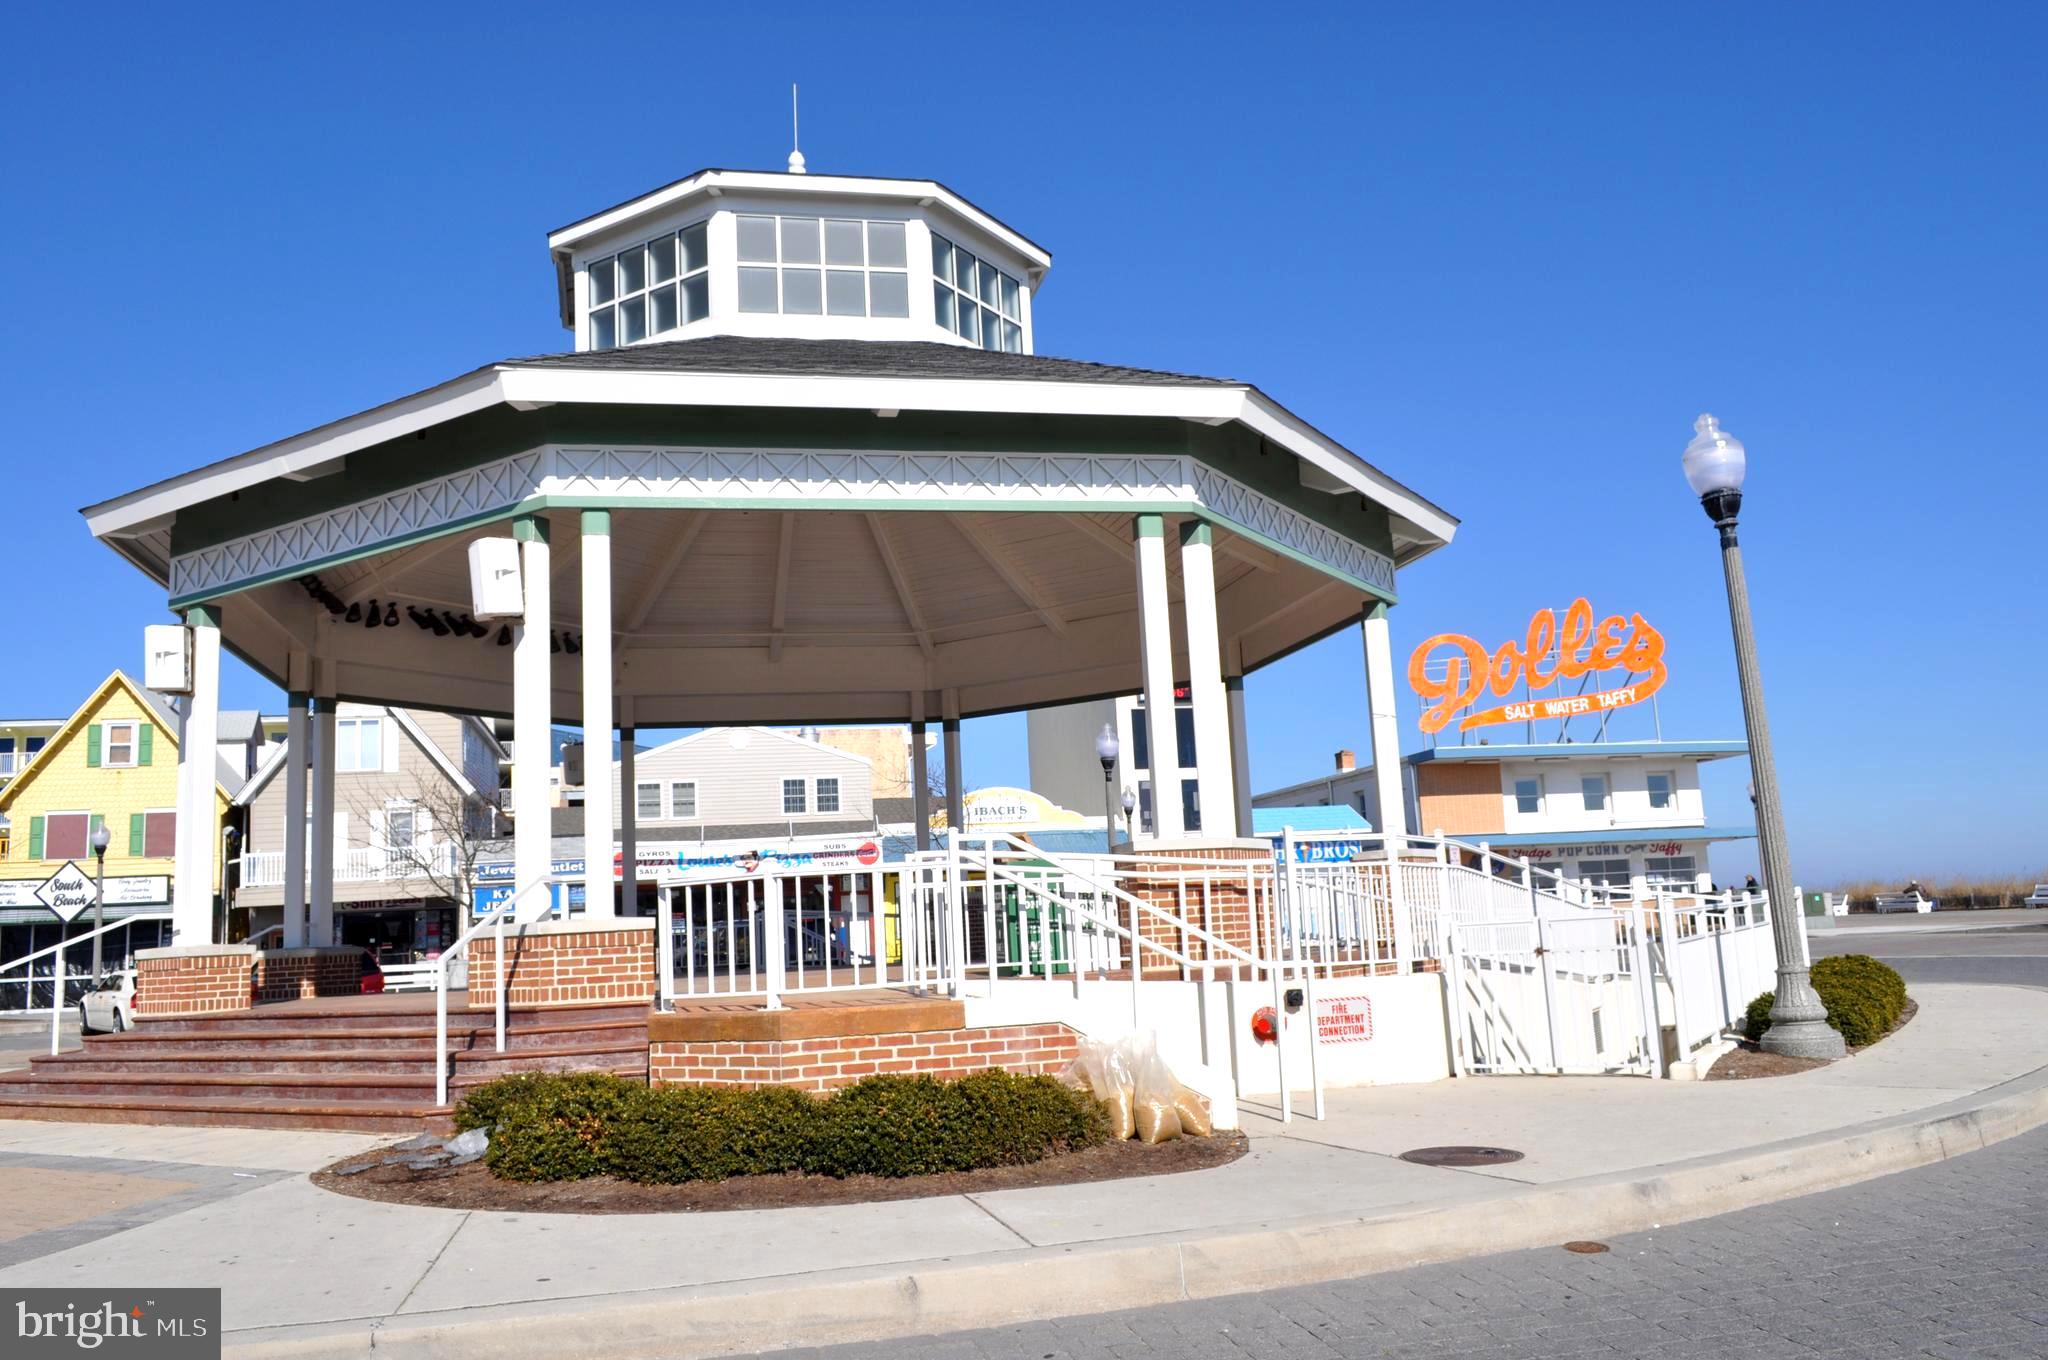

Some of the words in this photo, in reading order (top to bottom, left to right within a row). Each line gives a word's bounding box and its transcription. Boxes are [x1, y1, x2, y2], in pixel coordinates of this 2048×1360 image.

[1504, 703, 1536, 721] SALT
[1544, 698, 1590, 714] WATER
[1596, 687, 1638, 708] TAFFY
[1511, 848, 1553, 861] Fudge
[1558, 847, 1583, 857] POP
[1586, 844, 1620, 855] CORN
[1649, 842, 1683, 856] Taffy
[551, 861, 585, 873] utlet
[635, 859, 675, 867] PIZZA
[50, 878, 84, 893] South
[53, 893, 88, 908] Beach
[1331, 1004, 1348, 1014] FIRE
[1317, 1014, 1365, 1026] DEPARTMENT
[1319, 1025, 1365, 1037] CONNECTION
